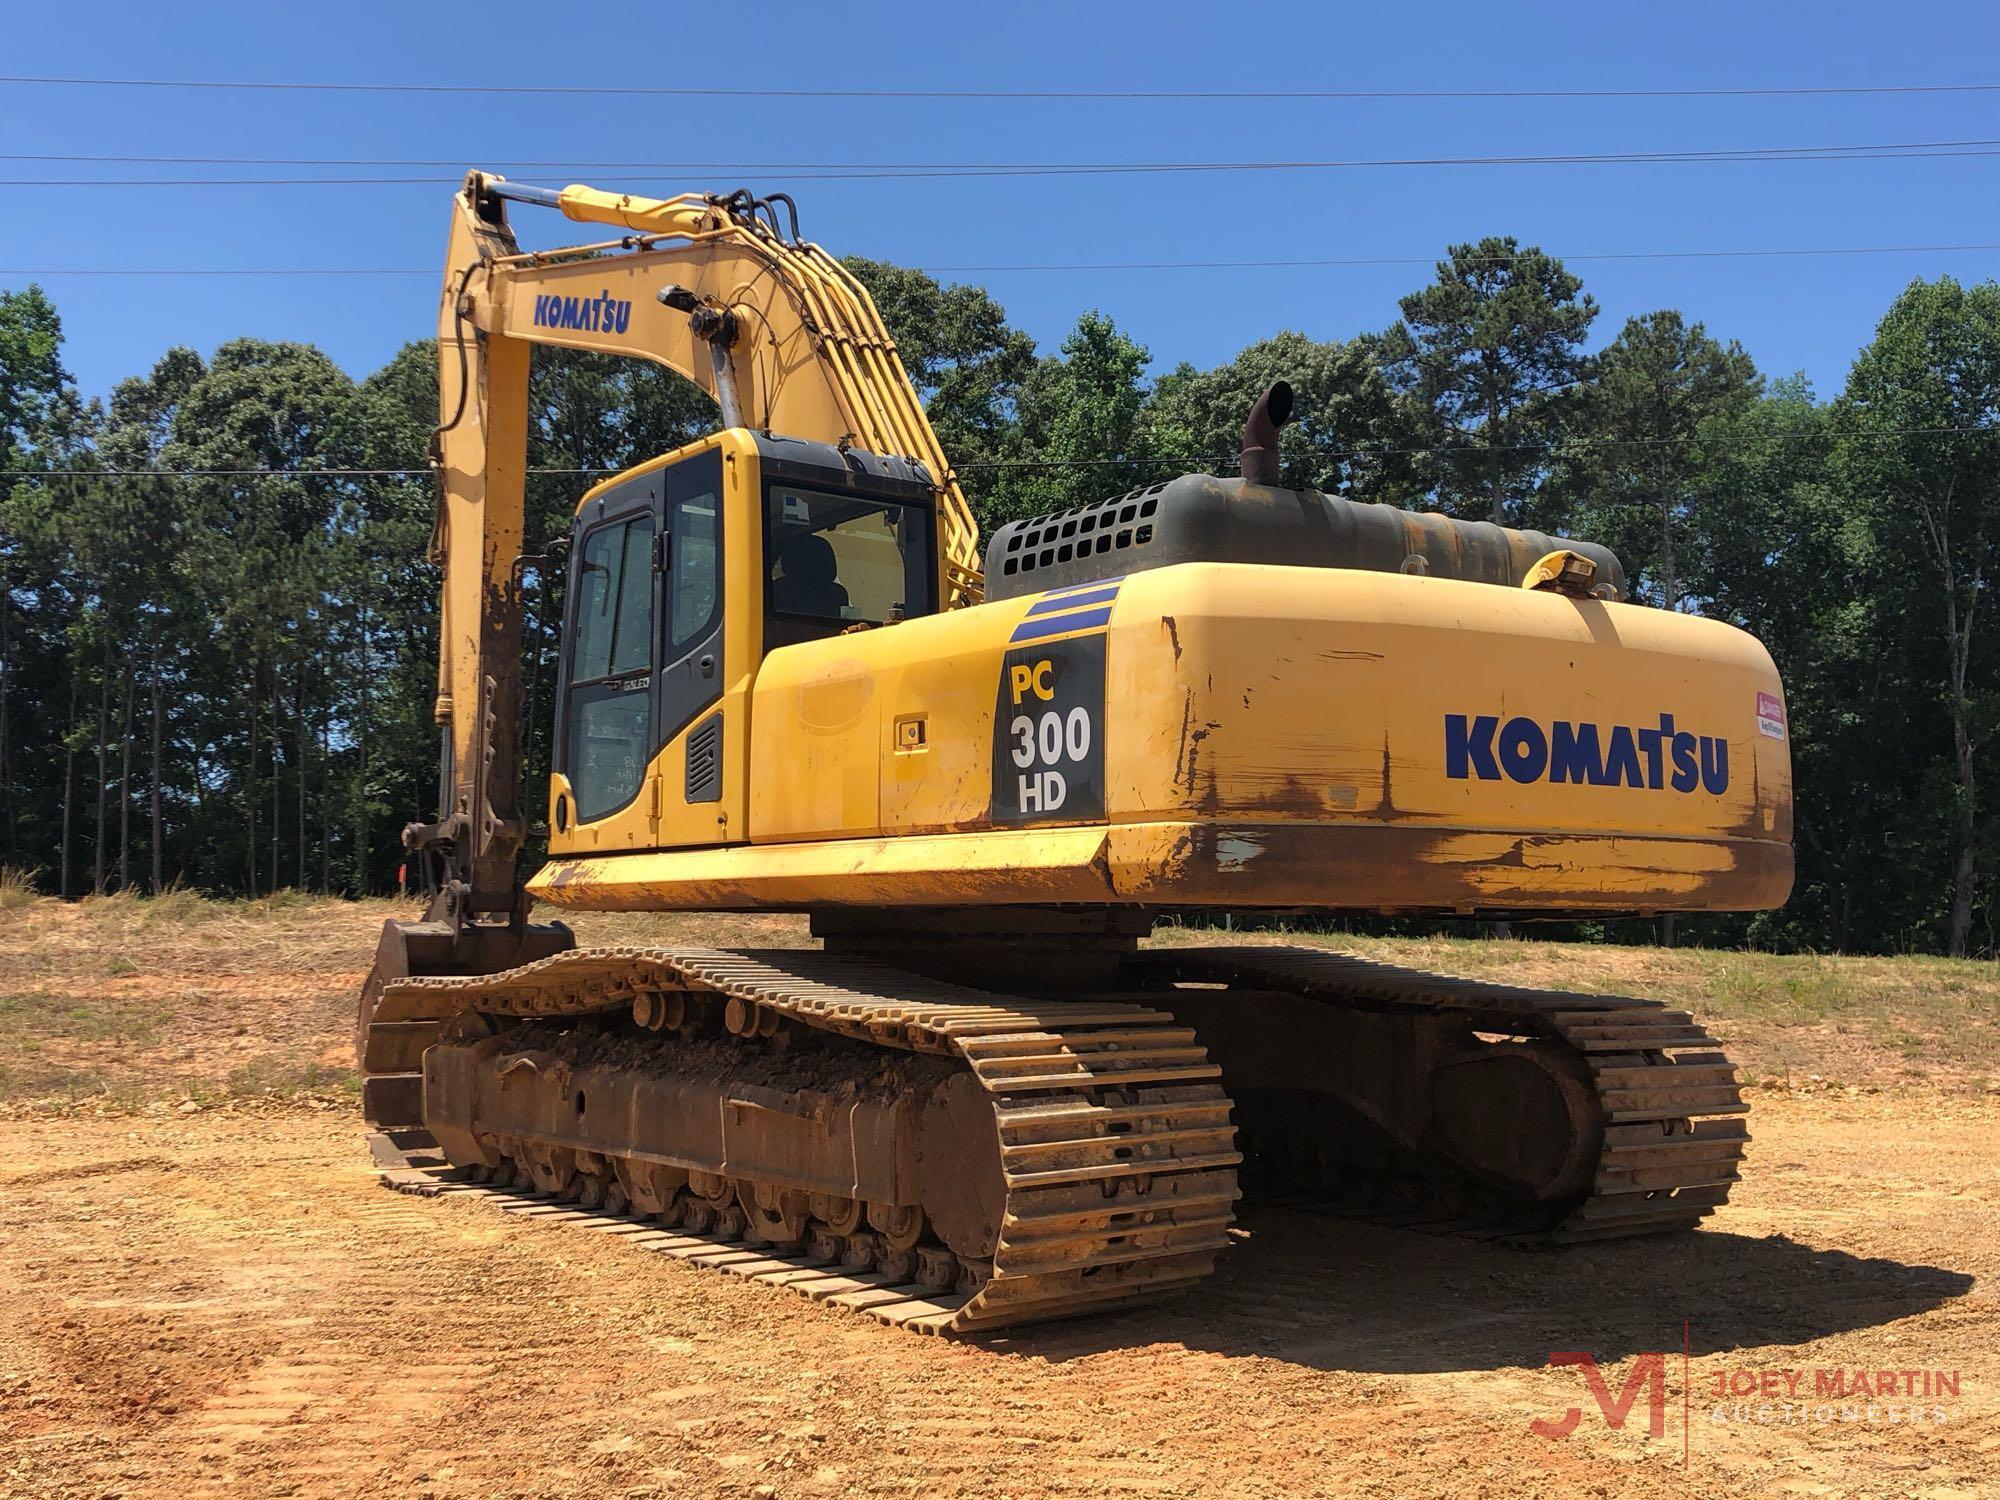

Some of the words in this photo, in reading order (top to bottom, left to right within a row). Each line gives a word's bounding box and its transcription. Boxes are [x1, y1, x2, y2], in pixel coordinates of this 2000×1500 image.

[534, 289, 632, 334] KOMATSU
[1011, 660, 1055, 704] PC
[1011, 706, 1090, 768] 300
[1445, 713, 1729, 795] KOMATSU
[1018, 771, 1067, 813] HD
